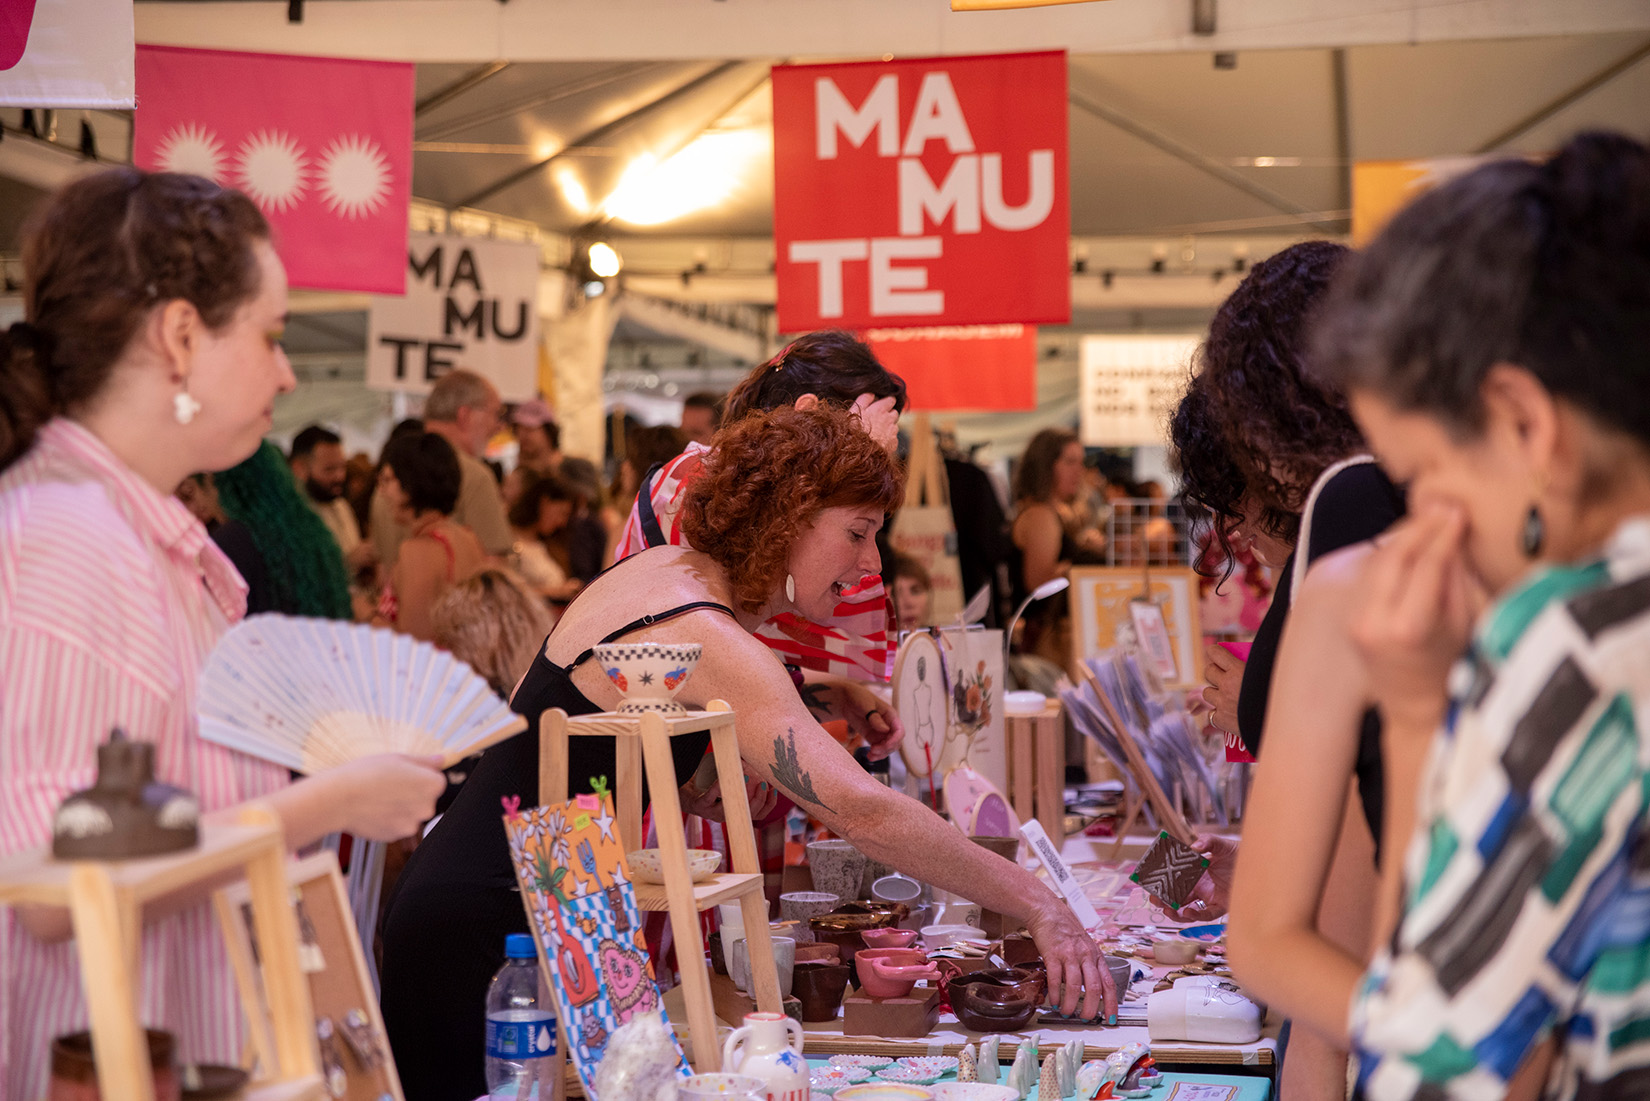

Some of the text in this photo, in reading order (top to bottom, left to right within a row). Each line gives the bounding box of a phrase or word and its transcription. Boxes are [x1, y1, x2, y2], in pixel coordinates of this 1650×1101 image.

[814, 71, 976, 160] MA
[898, 149, 1056, 236] MU
[409, 246, 483, 292] MA
[788, 236, 945, 319] TE
[445, 297, 528, 341] MU
[379, 337, 464, 382] TE
